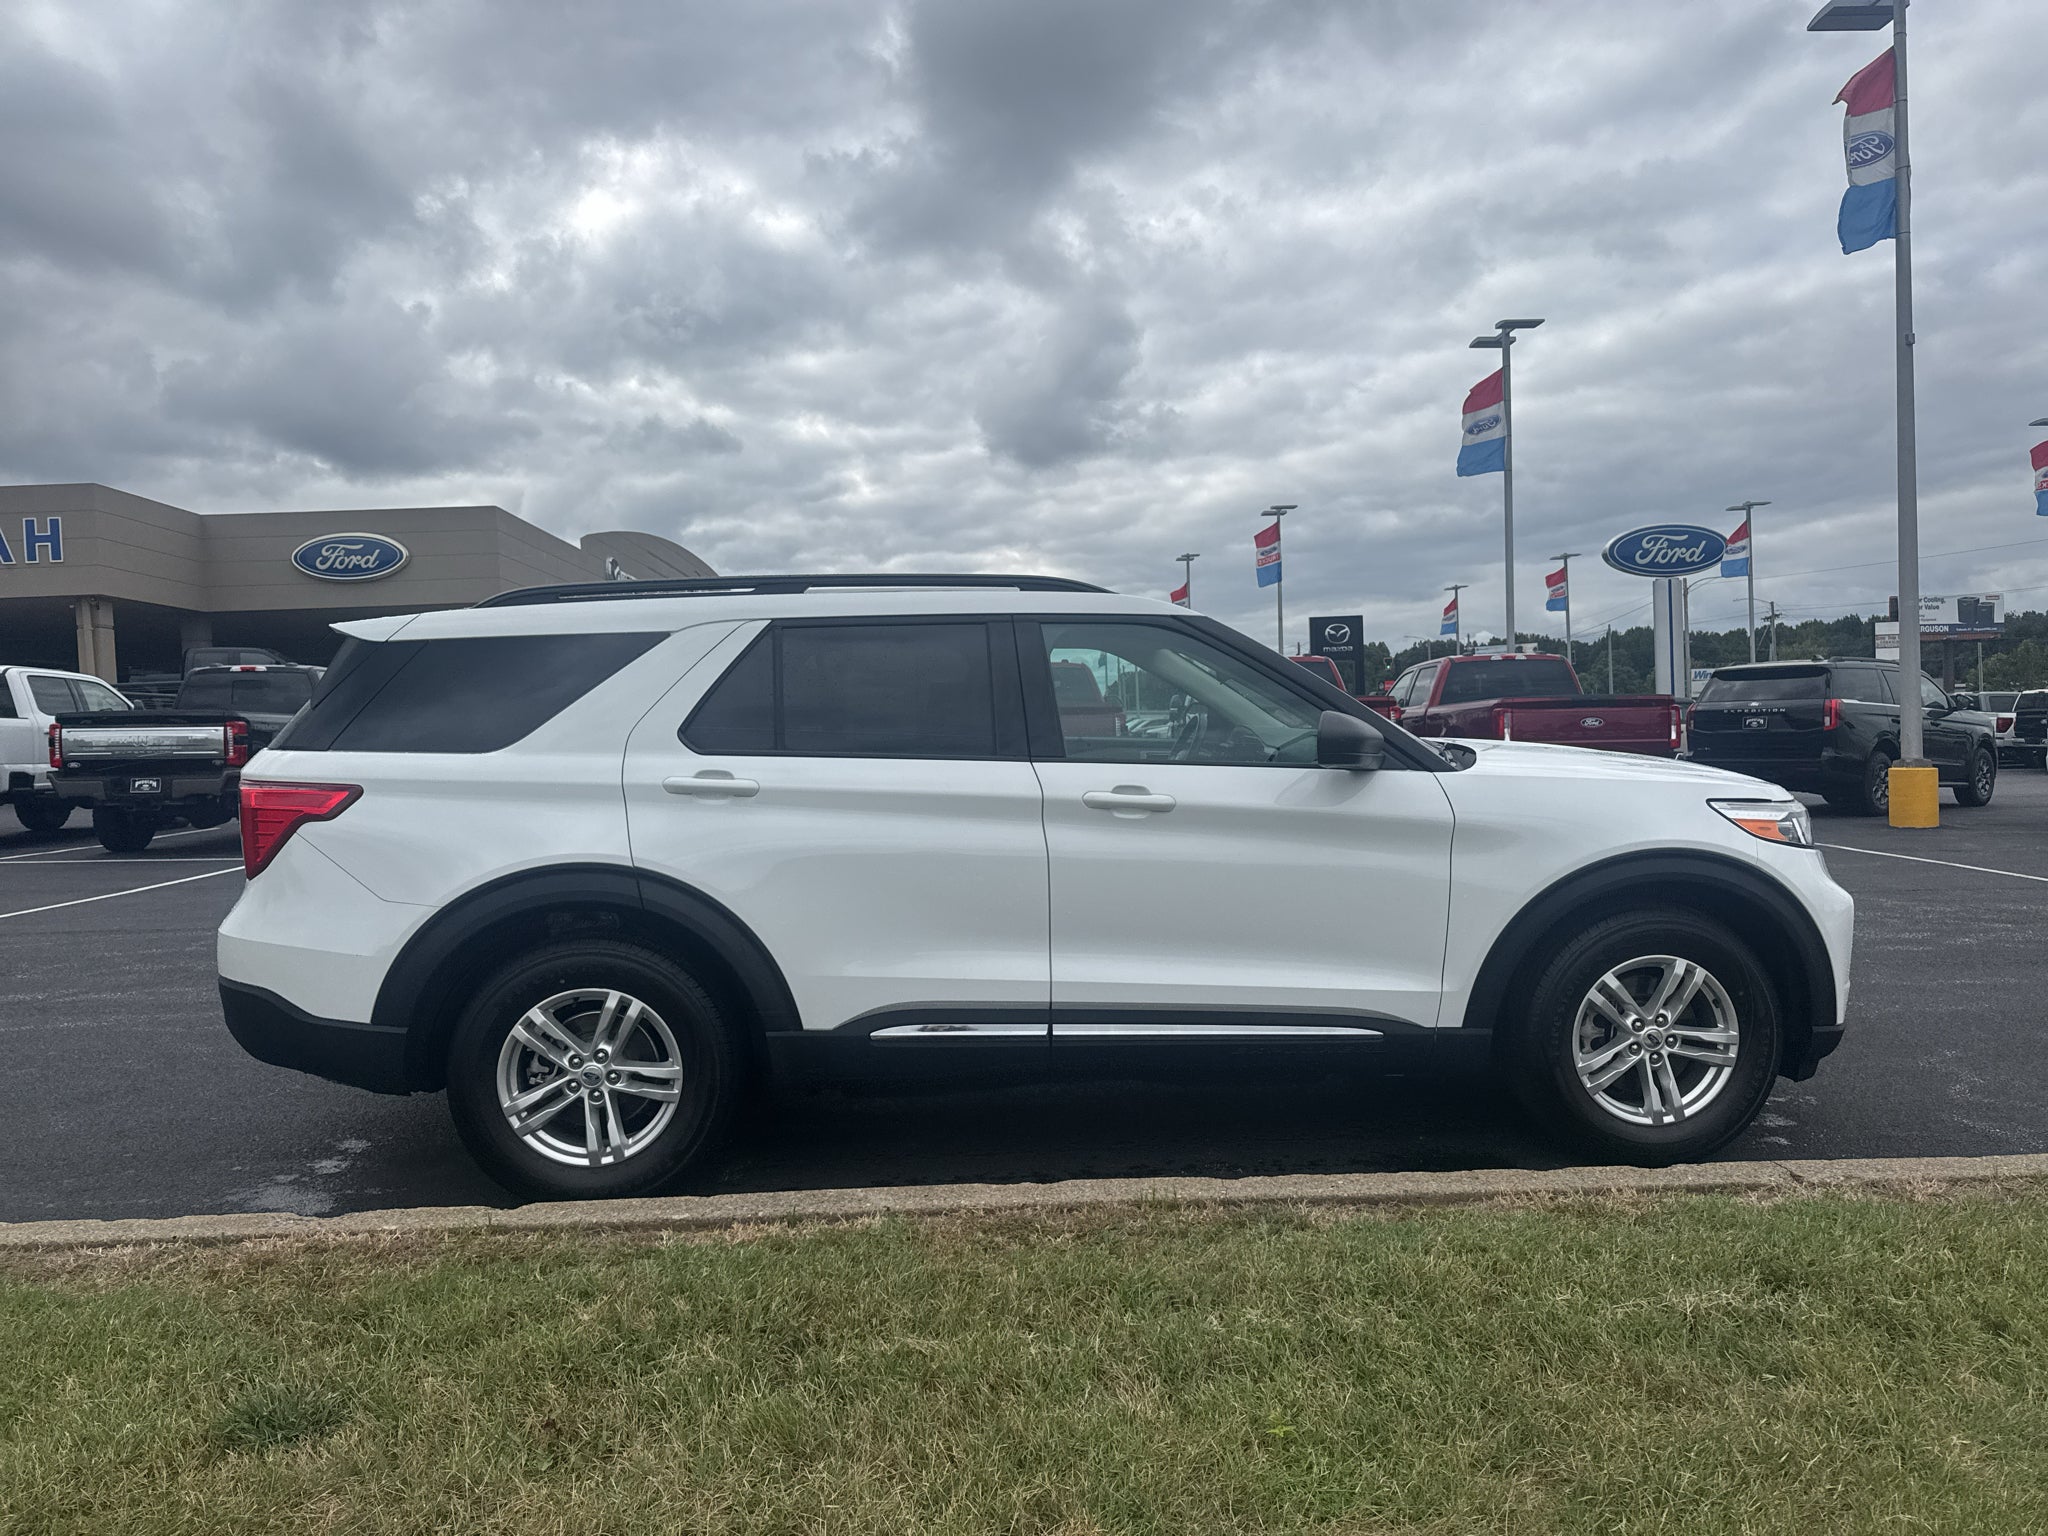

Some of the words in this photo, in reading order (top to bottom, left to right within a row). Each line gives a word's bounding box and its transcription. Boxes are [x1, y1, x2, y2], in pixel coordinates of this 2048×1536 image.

[315, 543, 380, 570] Ford
[1634, 534, 1706, 565] Ford
[1920, 625, 1949, 633] RGUSON
